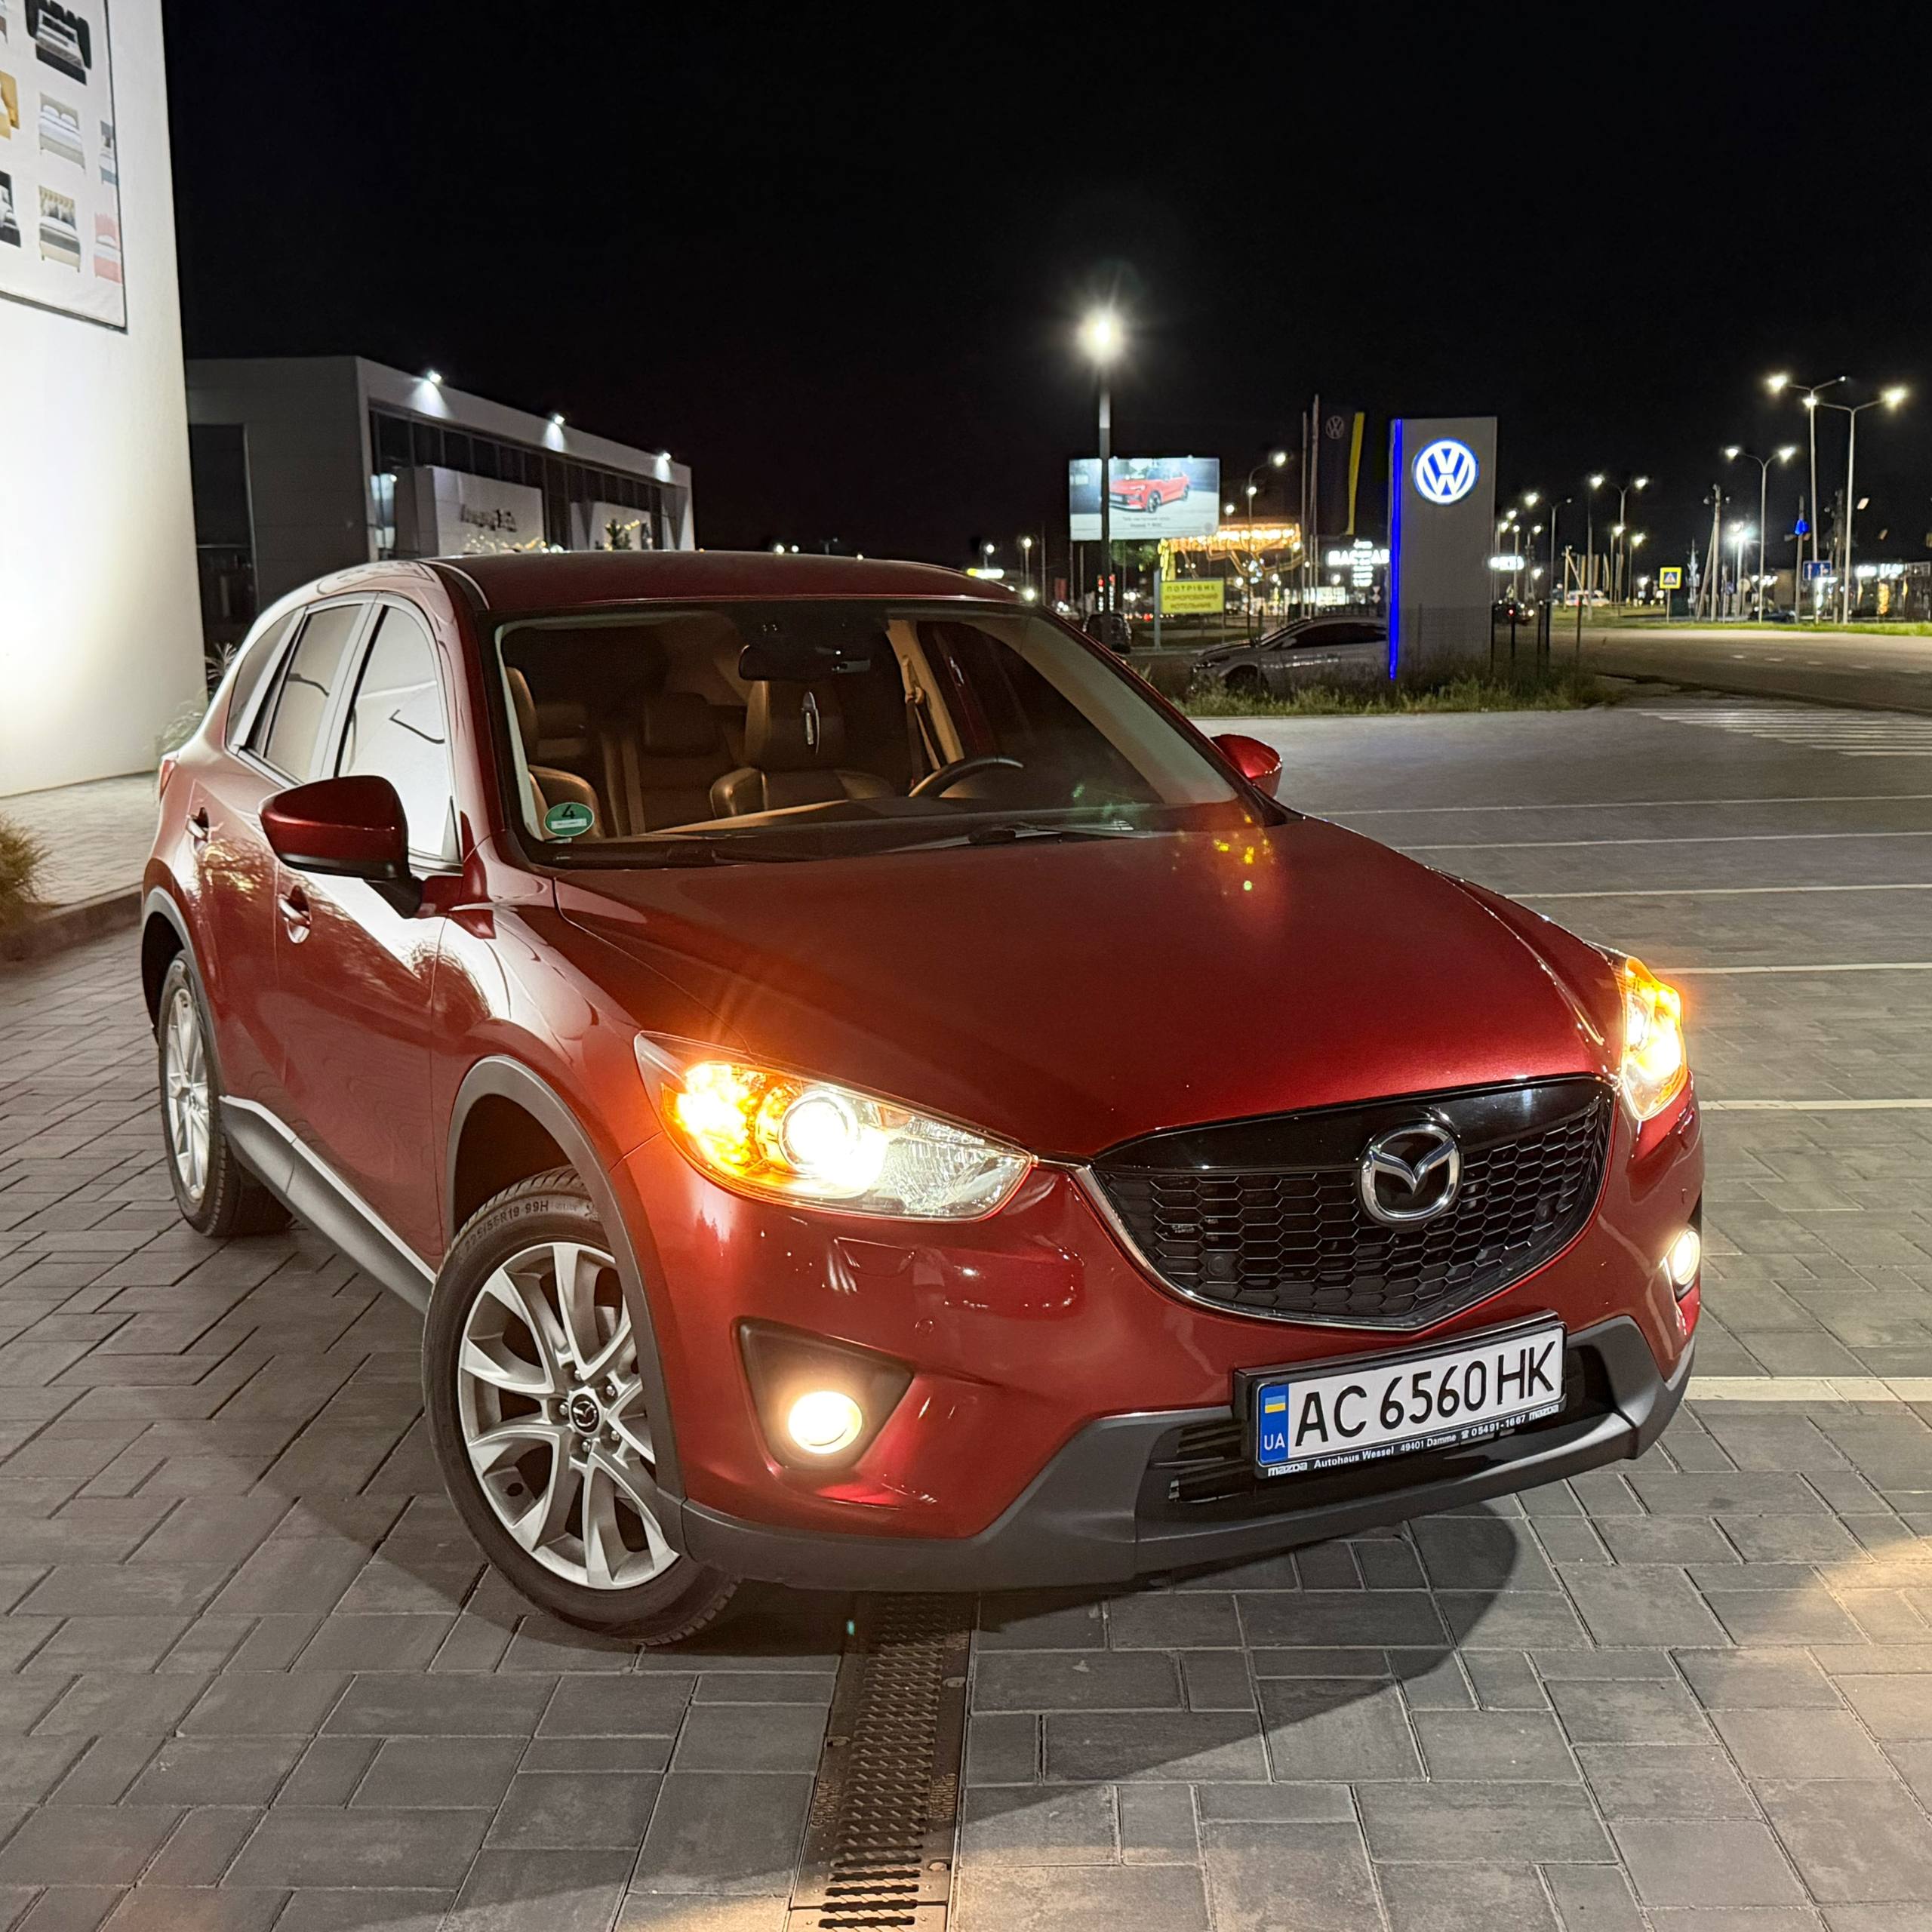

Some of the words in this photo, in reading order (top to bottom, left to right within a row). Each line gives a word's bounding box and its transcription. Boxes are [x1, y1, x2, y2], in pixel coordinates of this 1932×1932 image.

[1418, 441, 1474, 501] VW
[561, 804, 575, 820] 4
[525, 1200, 549, 1214] 99H
[1295, 1385, 1367, 1447] AC
[1264, 1432, 1285, 1451] UA
[1314, 1454, 1359, 1469] Autohaus
[1362, 1446, 1395, 1460] Wessel
[1400, 1439, 1424, 1452] 49401
[1426, 1434, 1457, 1447] Damme
